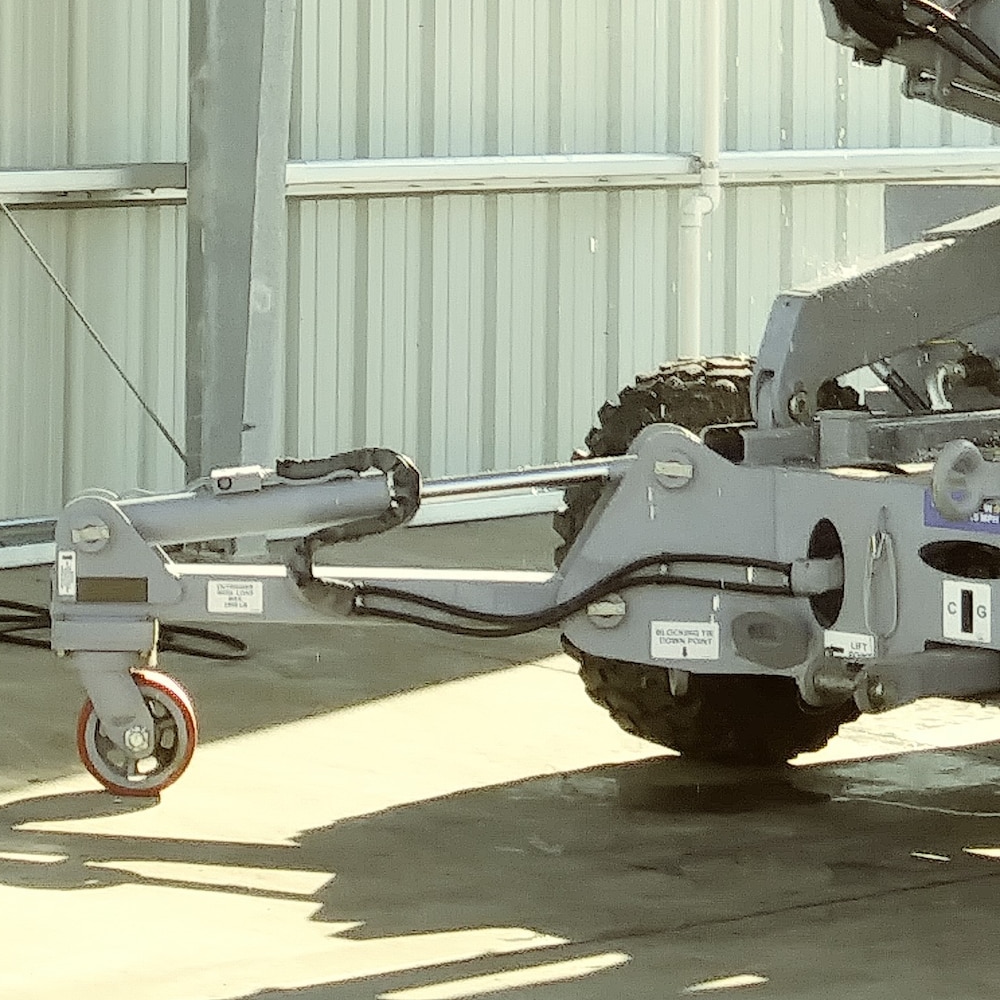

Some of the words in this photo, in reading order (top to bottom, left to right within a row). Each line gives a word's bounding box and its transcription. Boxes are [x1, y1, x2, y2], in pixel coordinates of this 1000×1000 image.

[947, 601, 957, 615] C
[976, 605, 987, 619] G
[655, 629, 700, 637] BLOCKING
[659, 637, 686, 645] DOWN
[687, 637, 713, 645] POINT
[850, 641, 868, 652] LIFT
